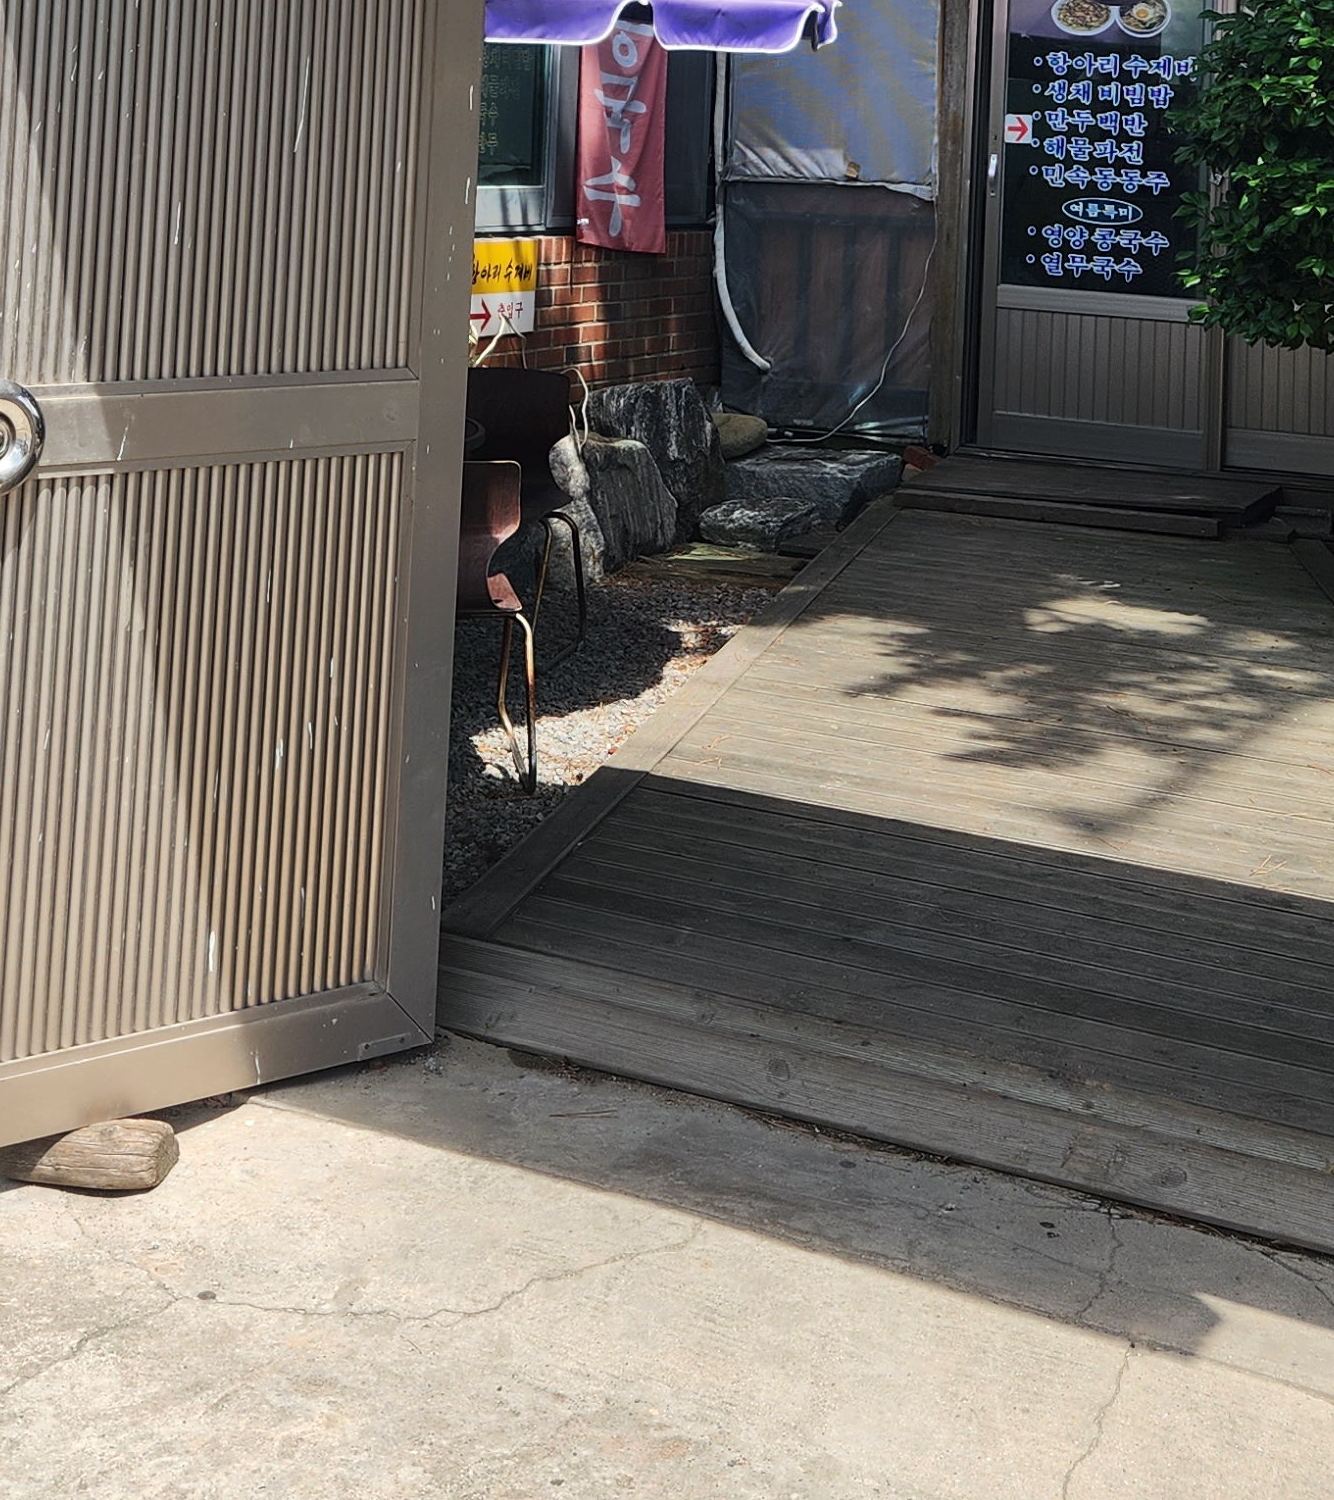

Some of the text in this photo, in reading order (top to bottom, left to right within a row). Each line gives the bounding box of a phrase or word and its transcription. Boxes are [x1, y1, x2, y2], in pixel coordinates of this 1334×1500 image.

[1044, 107, 1148, 136] 만두백반
[1043, 135, 1143, 165] 해물파전
[1042, 164, 1170, 195] 민속동동주
[1041, 252, 1143, 282] 열무국수
